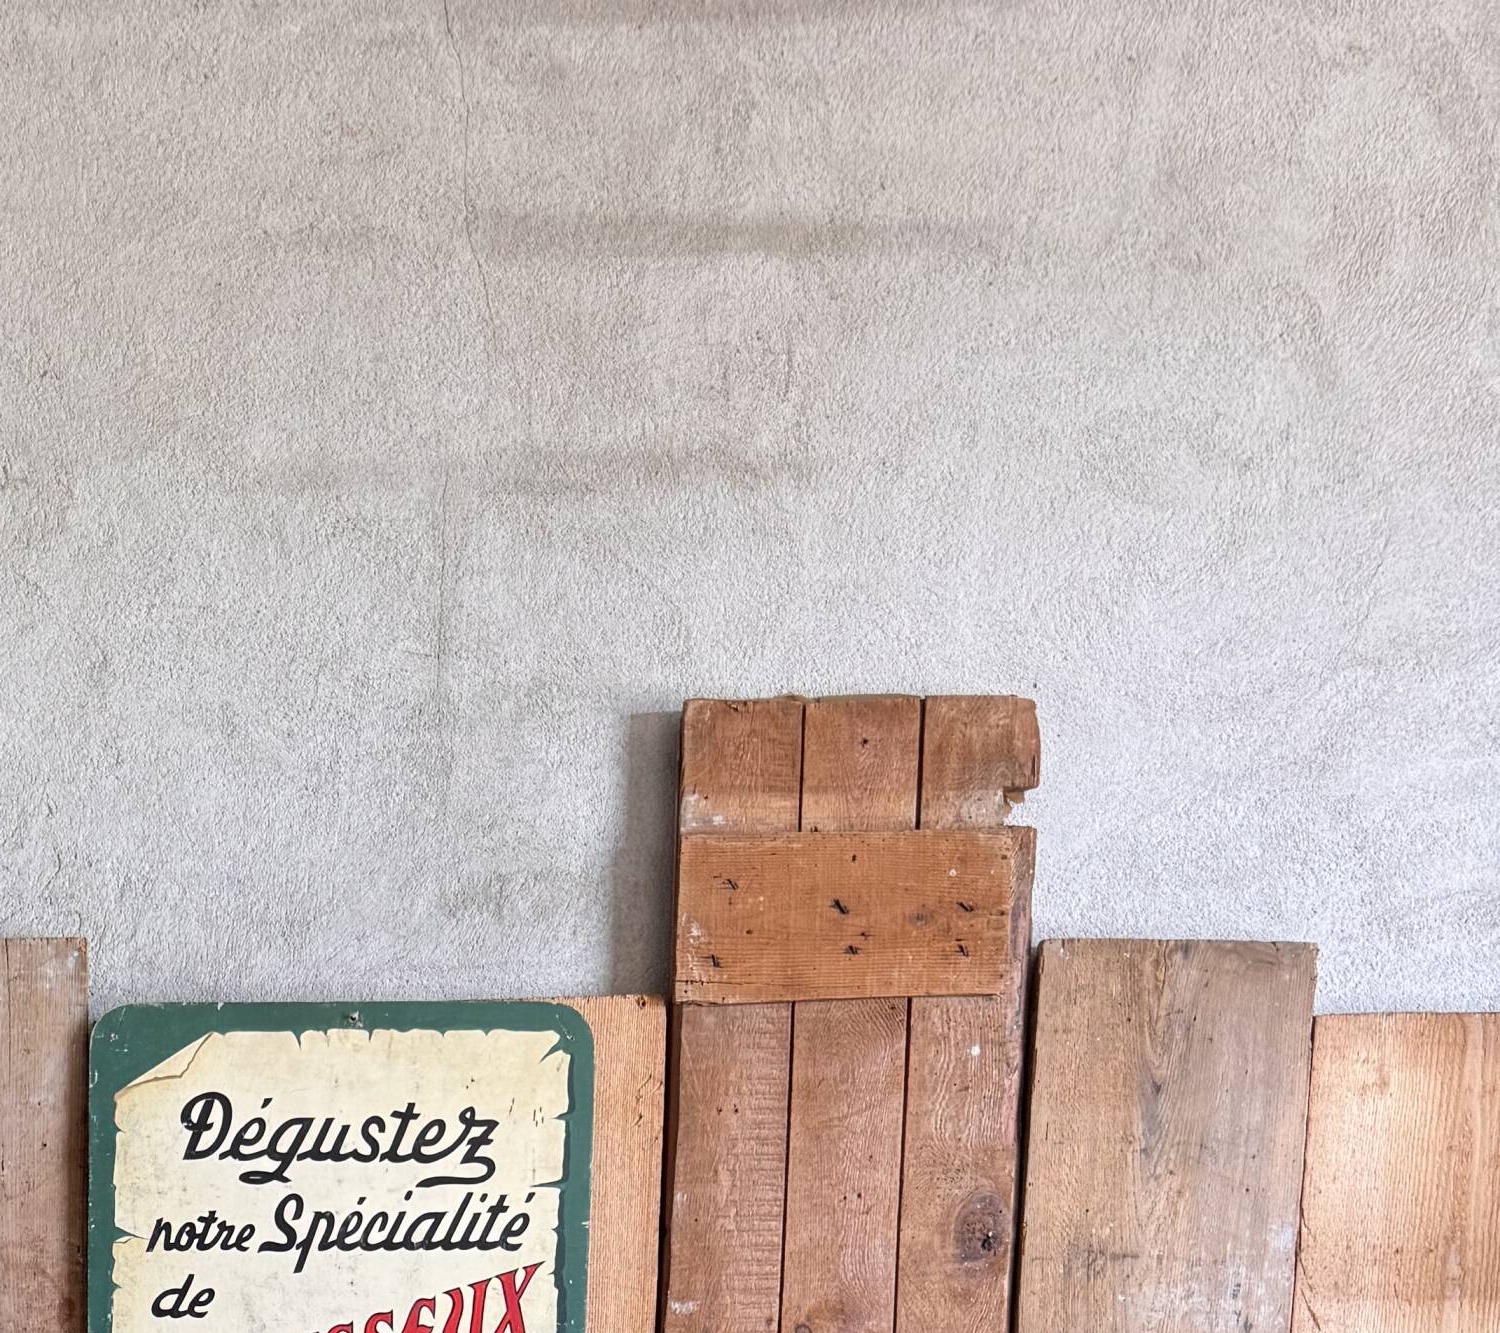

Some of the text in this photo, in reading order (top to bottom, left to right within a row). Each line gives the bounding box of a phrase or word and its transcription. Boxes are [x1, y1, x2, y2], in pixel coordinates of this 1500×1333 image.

[180, 1091, 500, 1188] Dégustez
[145, 1190, 536, 1274] notre Spécialité
[151, 1273, 216, 1319] de
